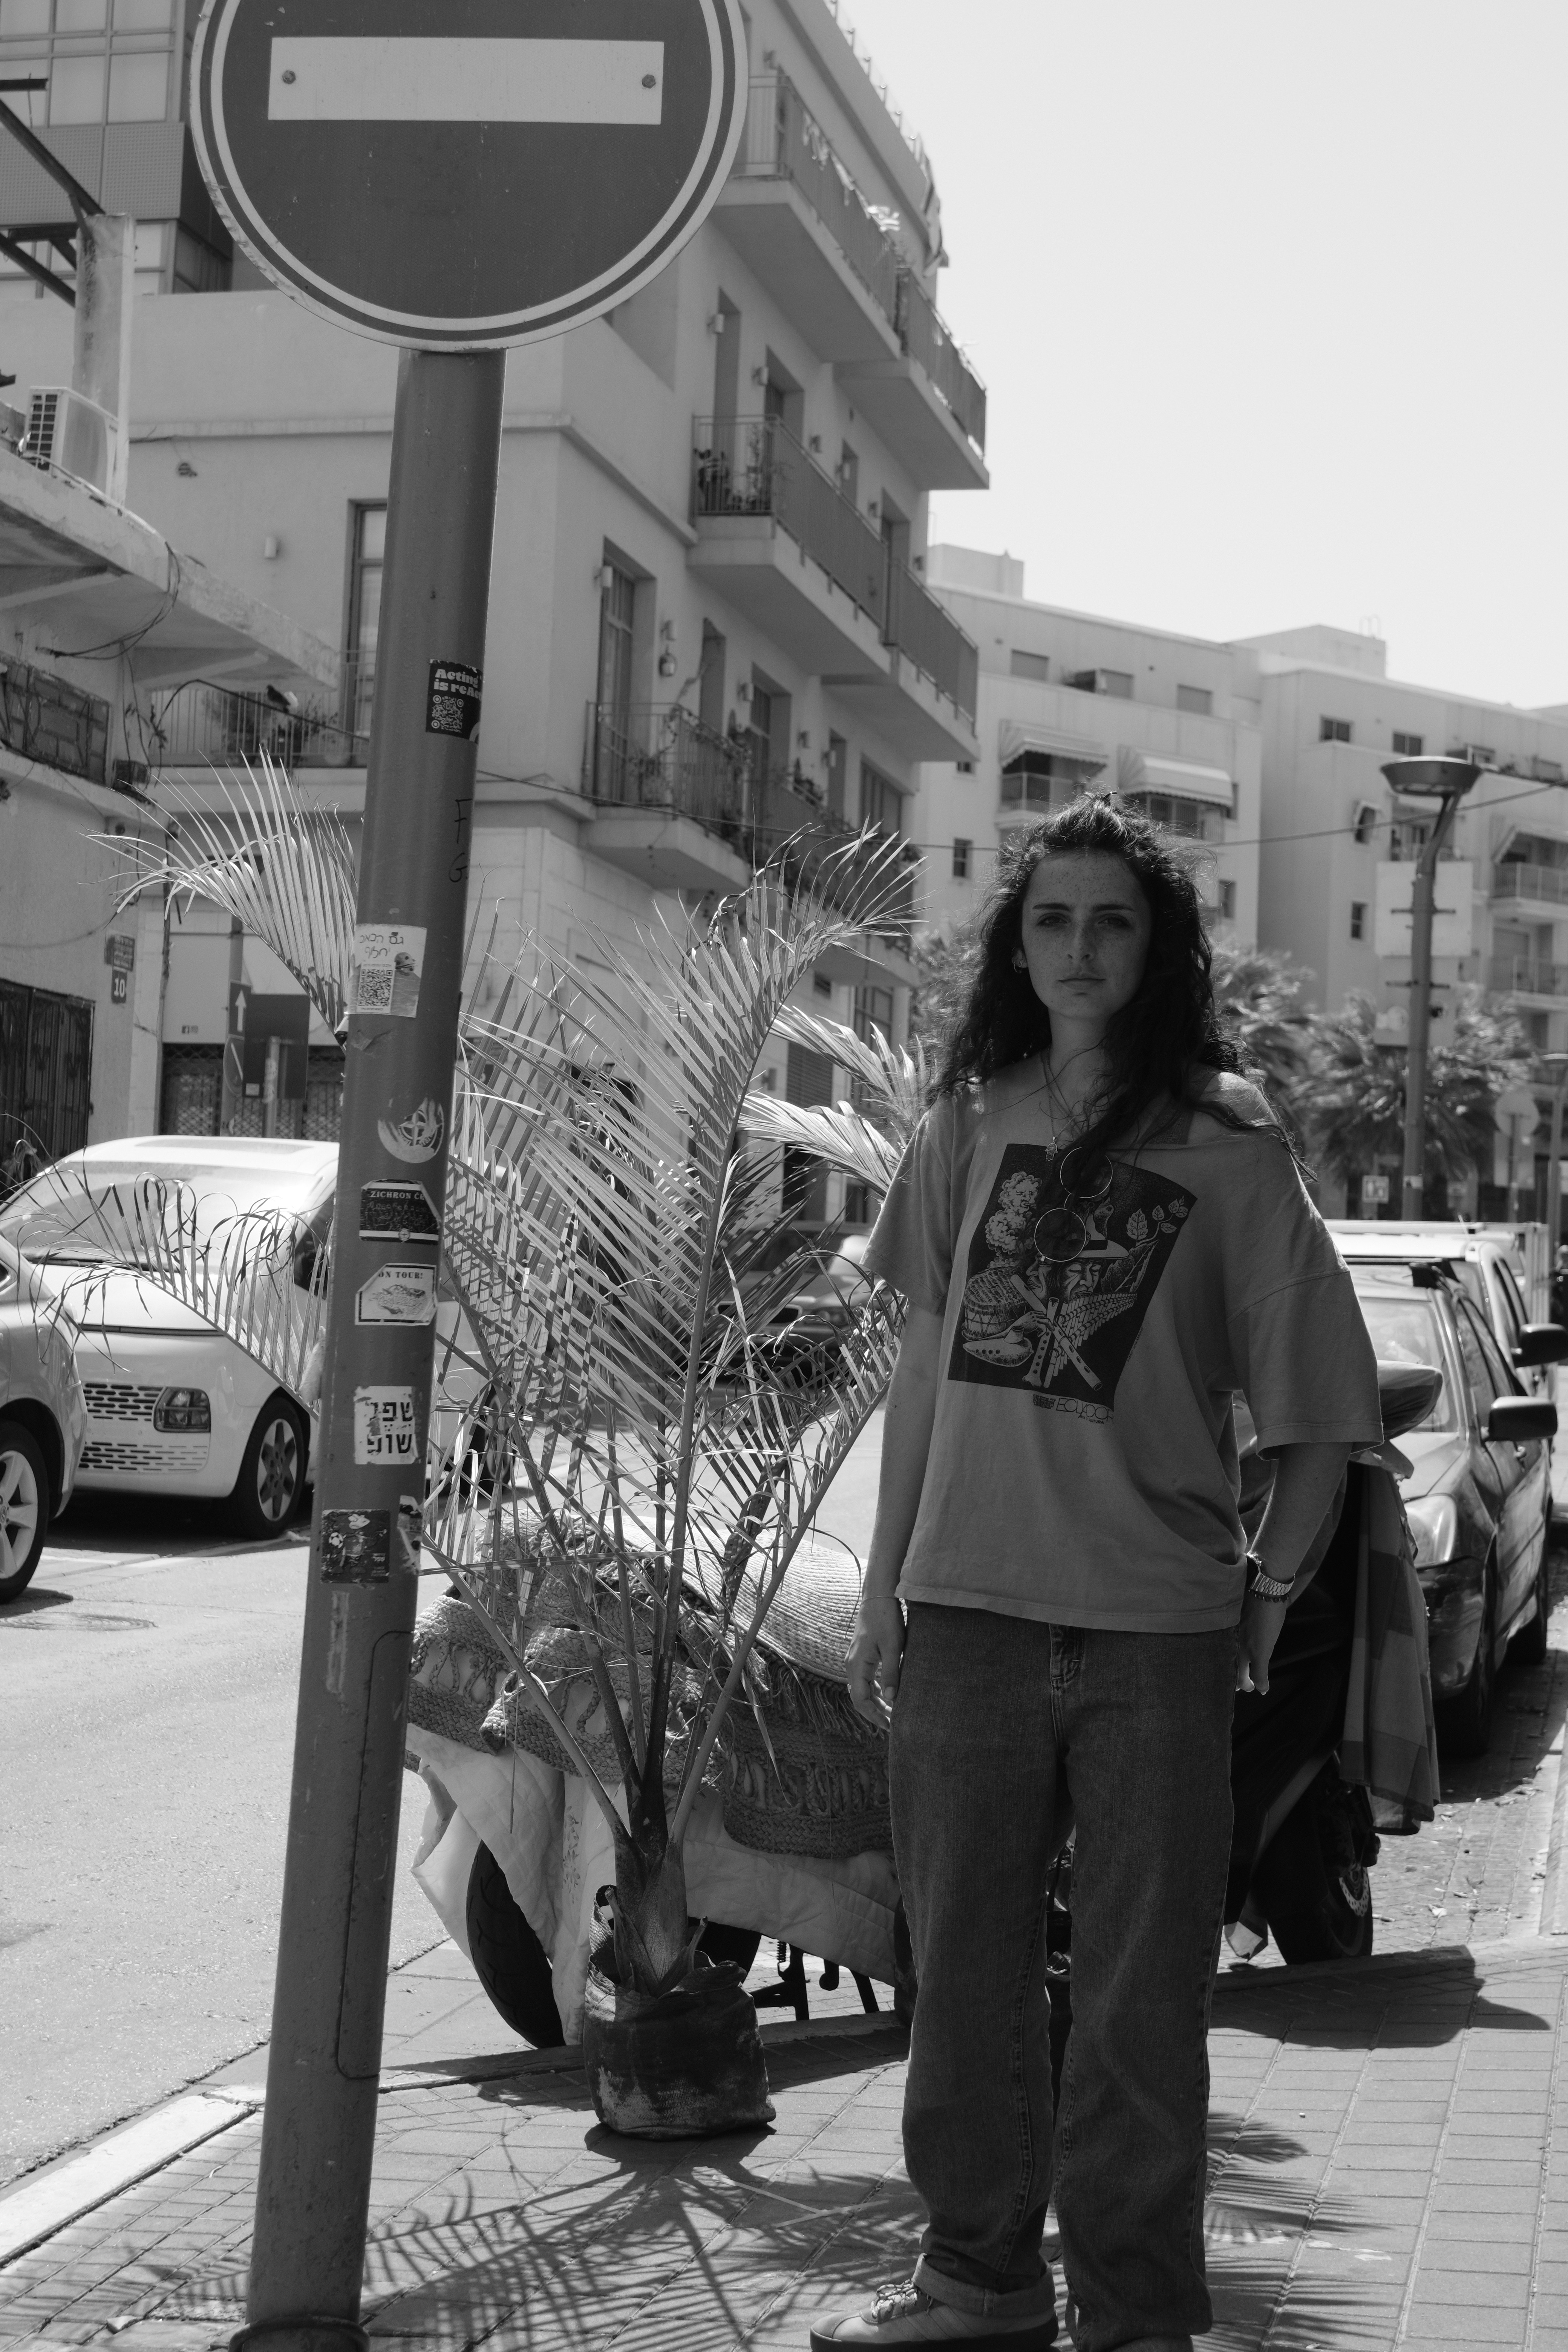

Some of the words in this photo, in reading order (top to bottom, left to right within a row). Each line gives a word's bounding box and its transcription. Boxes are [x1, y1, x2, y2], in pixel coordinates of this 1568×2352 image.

[433, 678, 448, 691] is
[435, 669, 478, 688] Acting
[113, 977, 125, 998] 10
[369, 1191, 411, 1199] ZICHRON
[1056, 1398, 1114, 1424] ECUADOR
